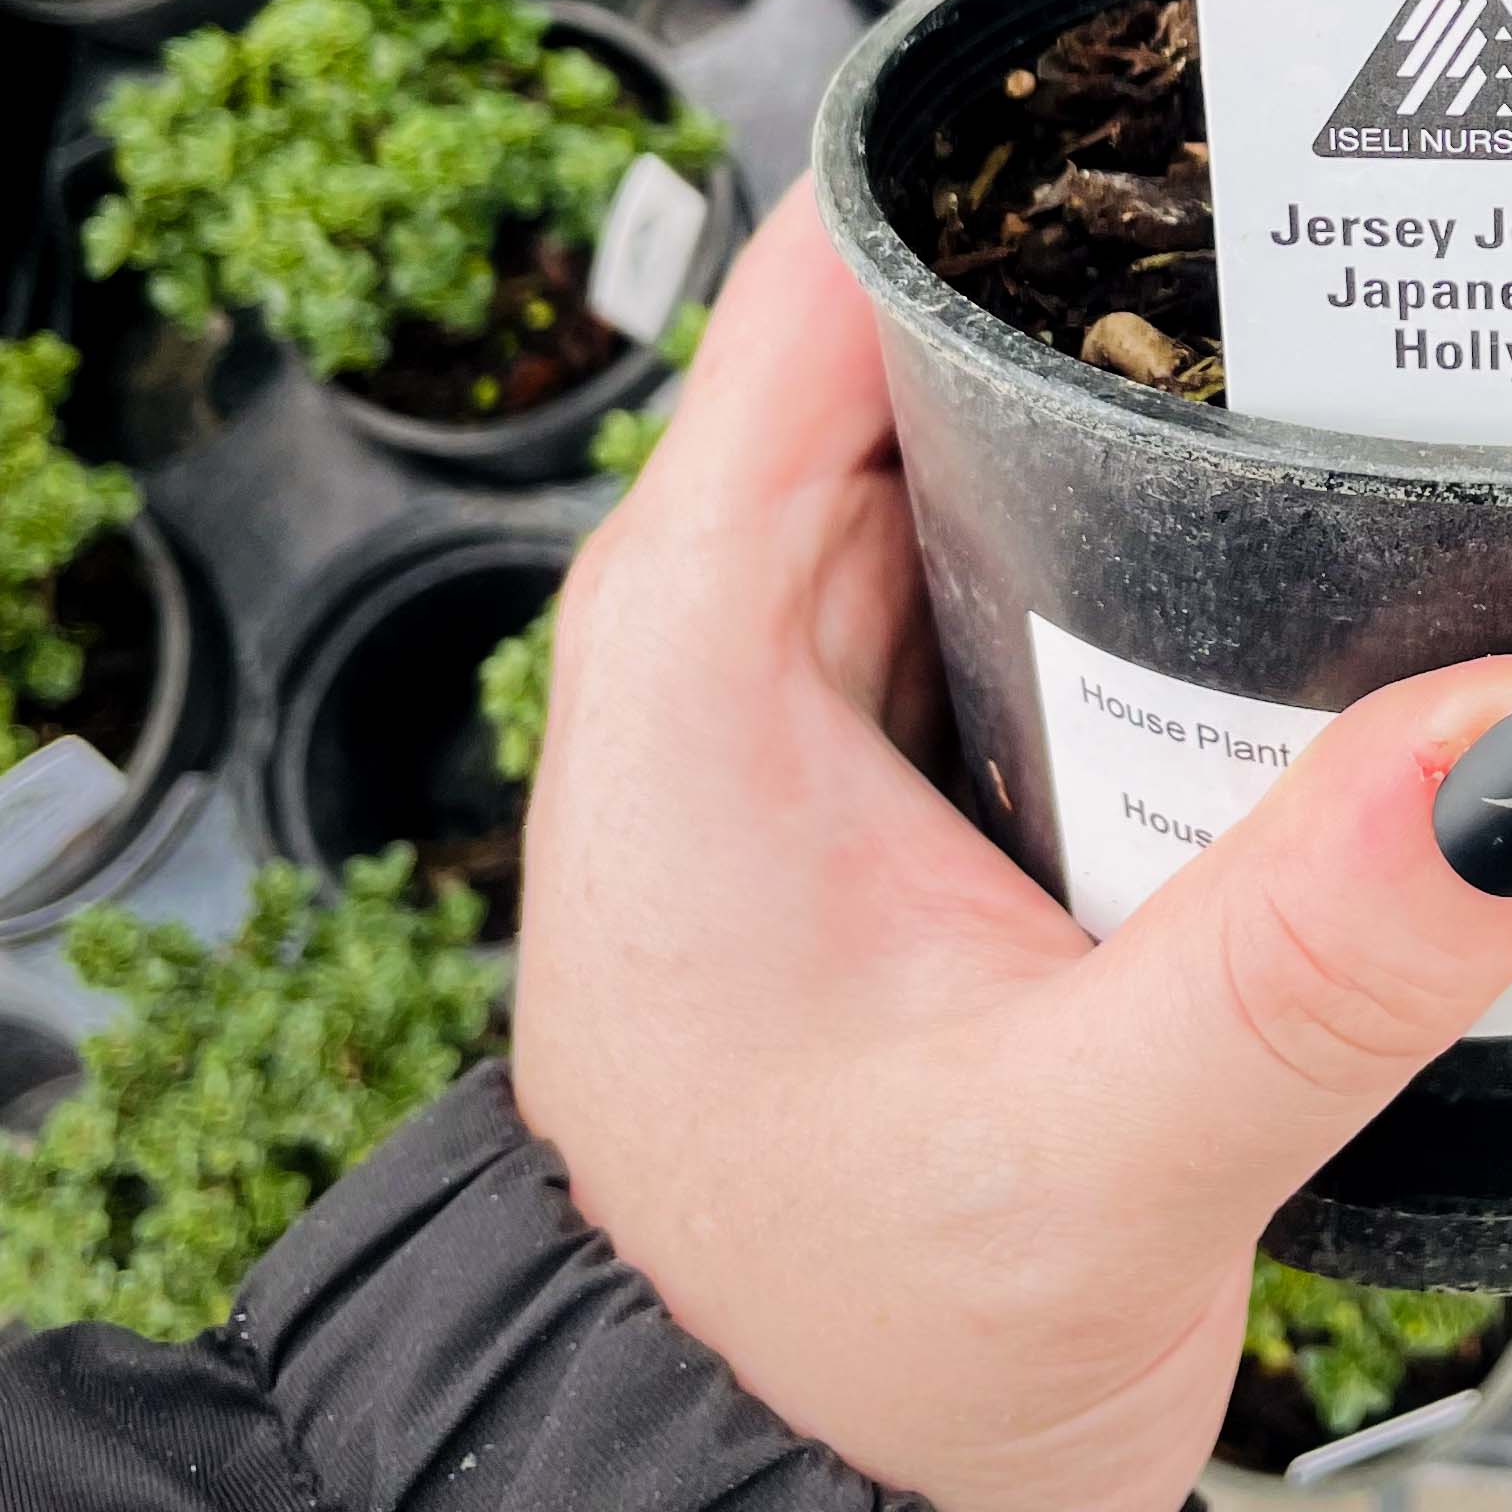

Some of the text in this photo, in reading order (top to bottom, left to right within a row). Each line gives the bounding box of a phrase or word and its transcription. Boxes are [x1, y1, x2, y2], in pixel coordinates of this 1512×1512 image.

[1328, 127, 1409, 153] ISELI
[1270, 204, 1457, 259] Jersey
[1080, 675, 1292, 768] House Plant
